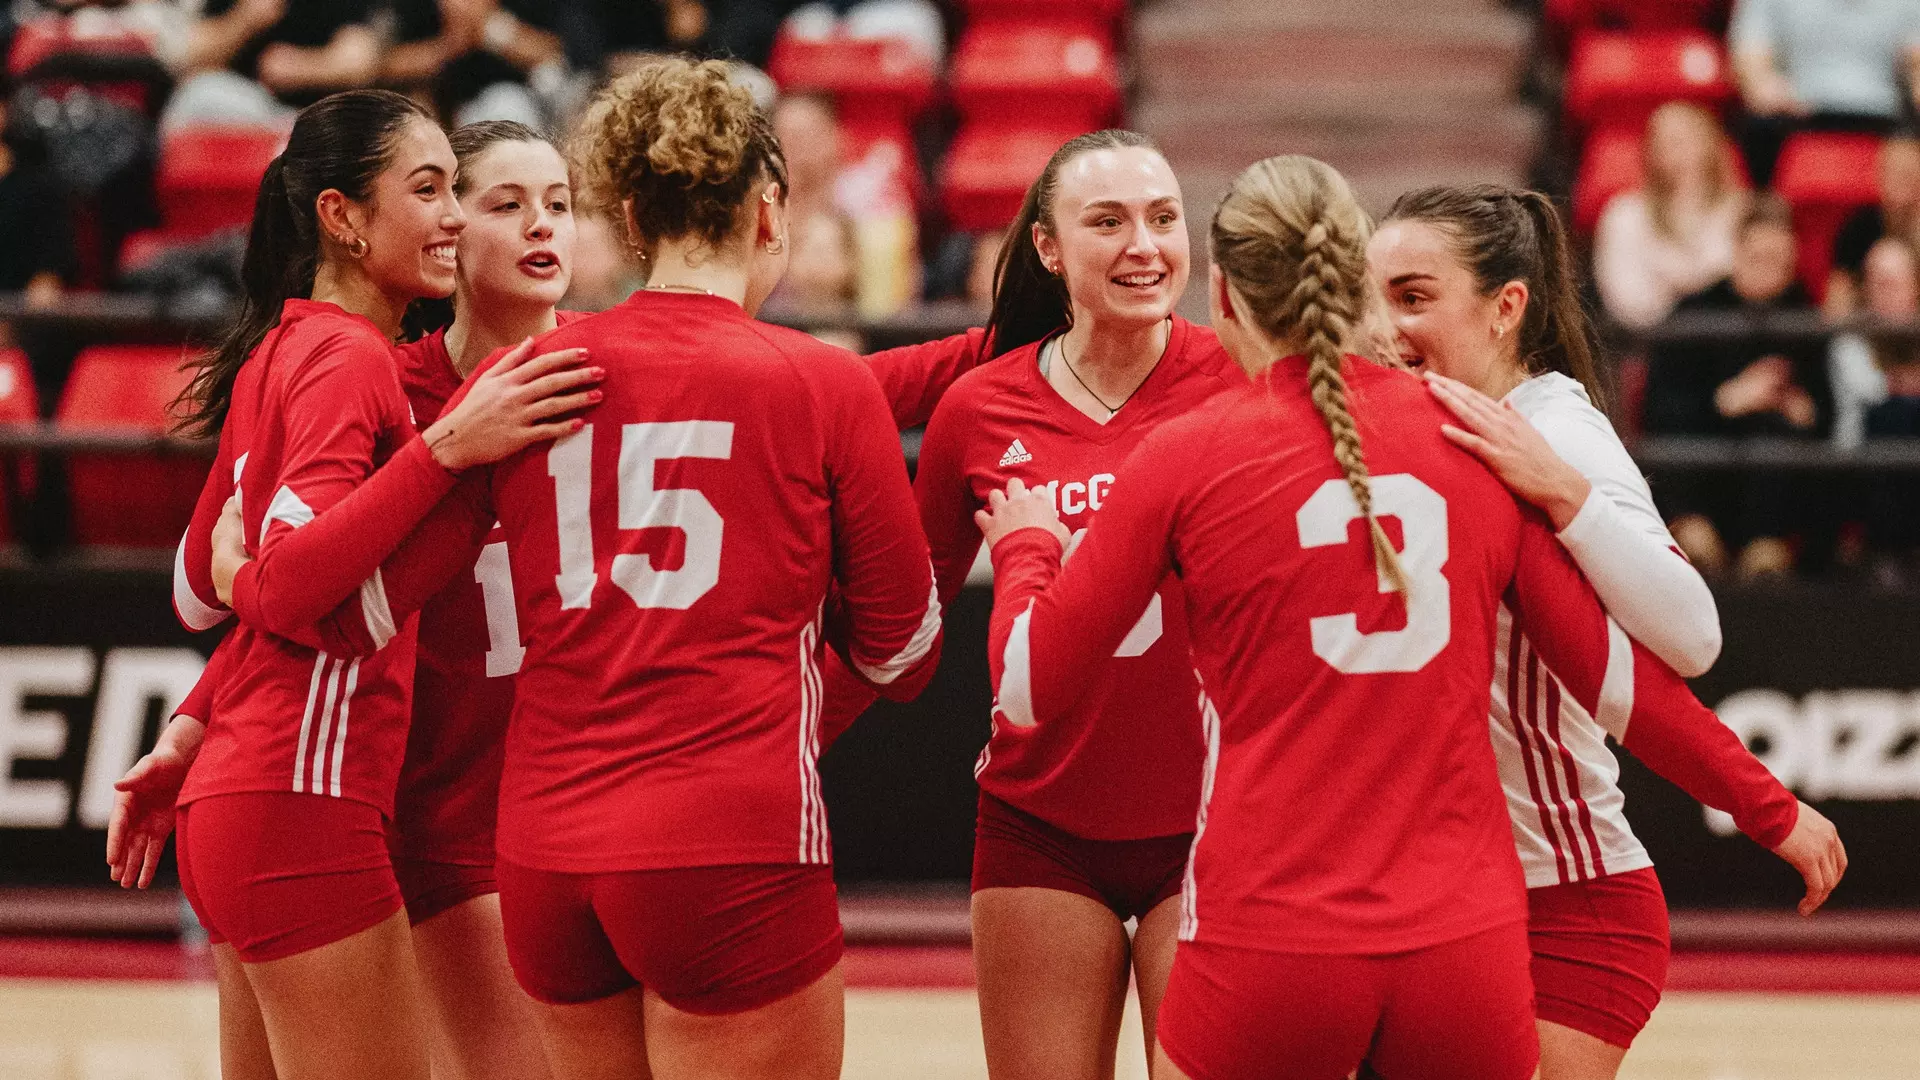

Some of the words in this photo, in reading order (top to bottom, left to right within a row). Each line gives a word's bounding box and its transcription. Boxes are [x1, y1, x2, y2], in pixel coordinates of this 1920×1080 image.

[548, 420, 734, 610] 15
[999, 453, 1033, 467] adidas
[1296, 473, 1450, 674] 3
